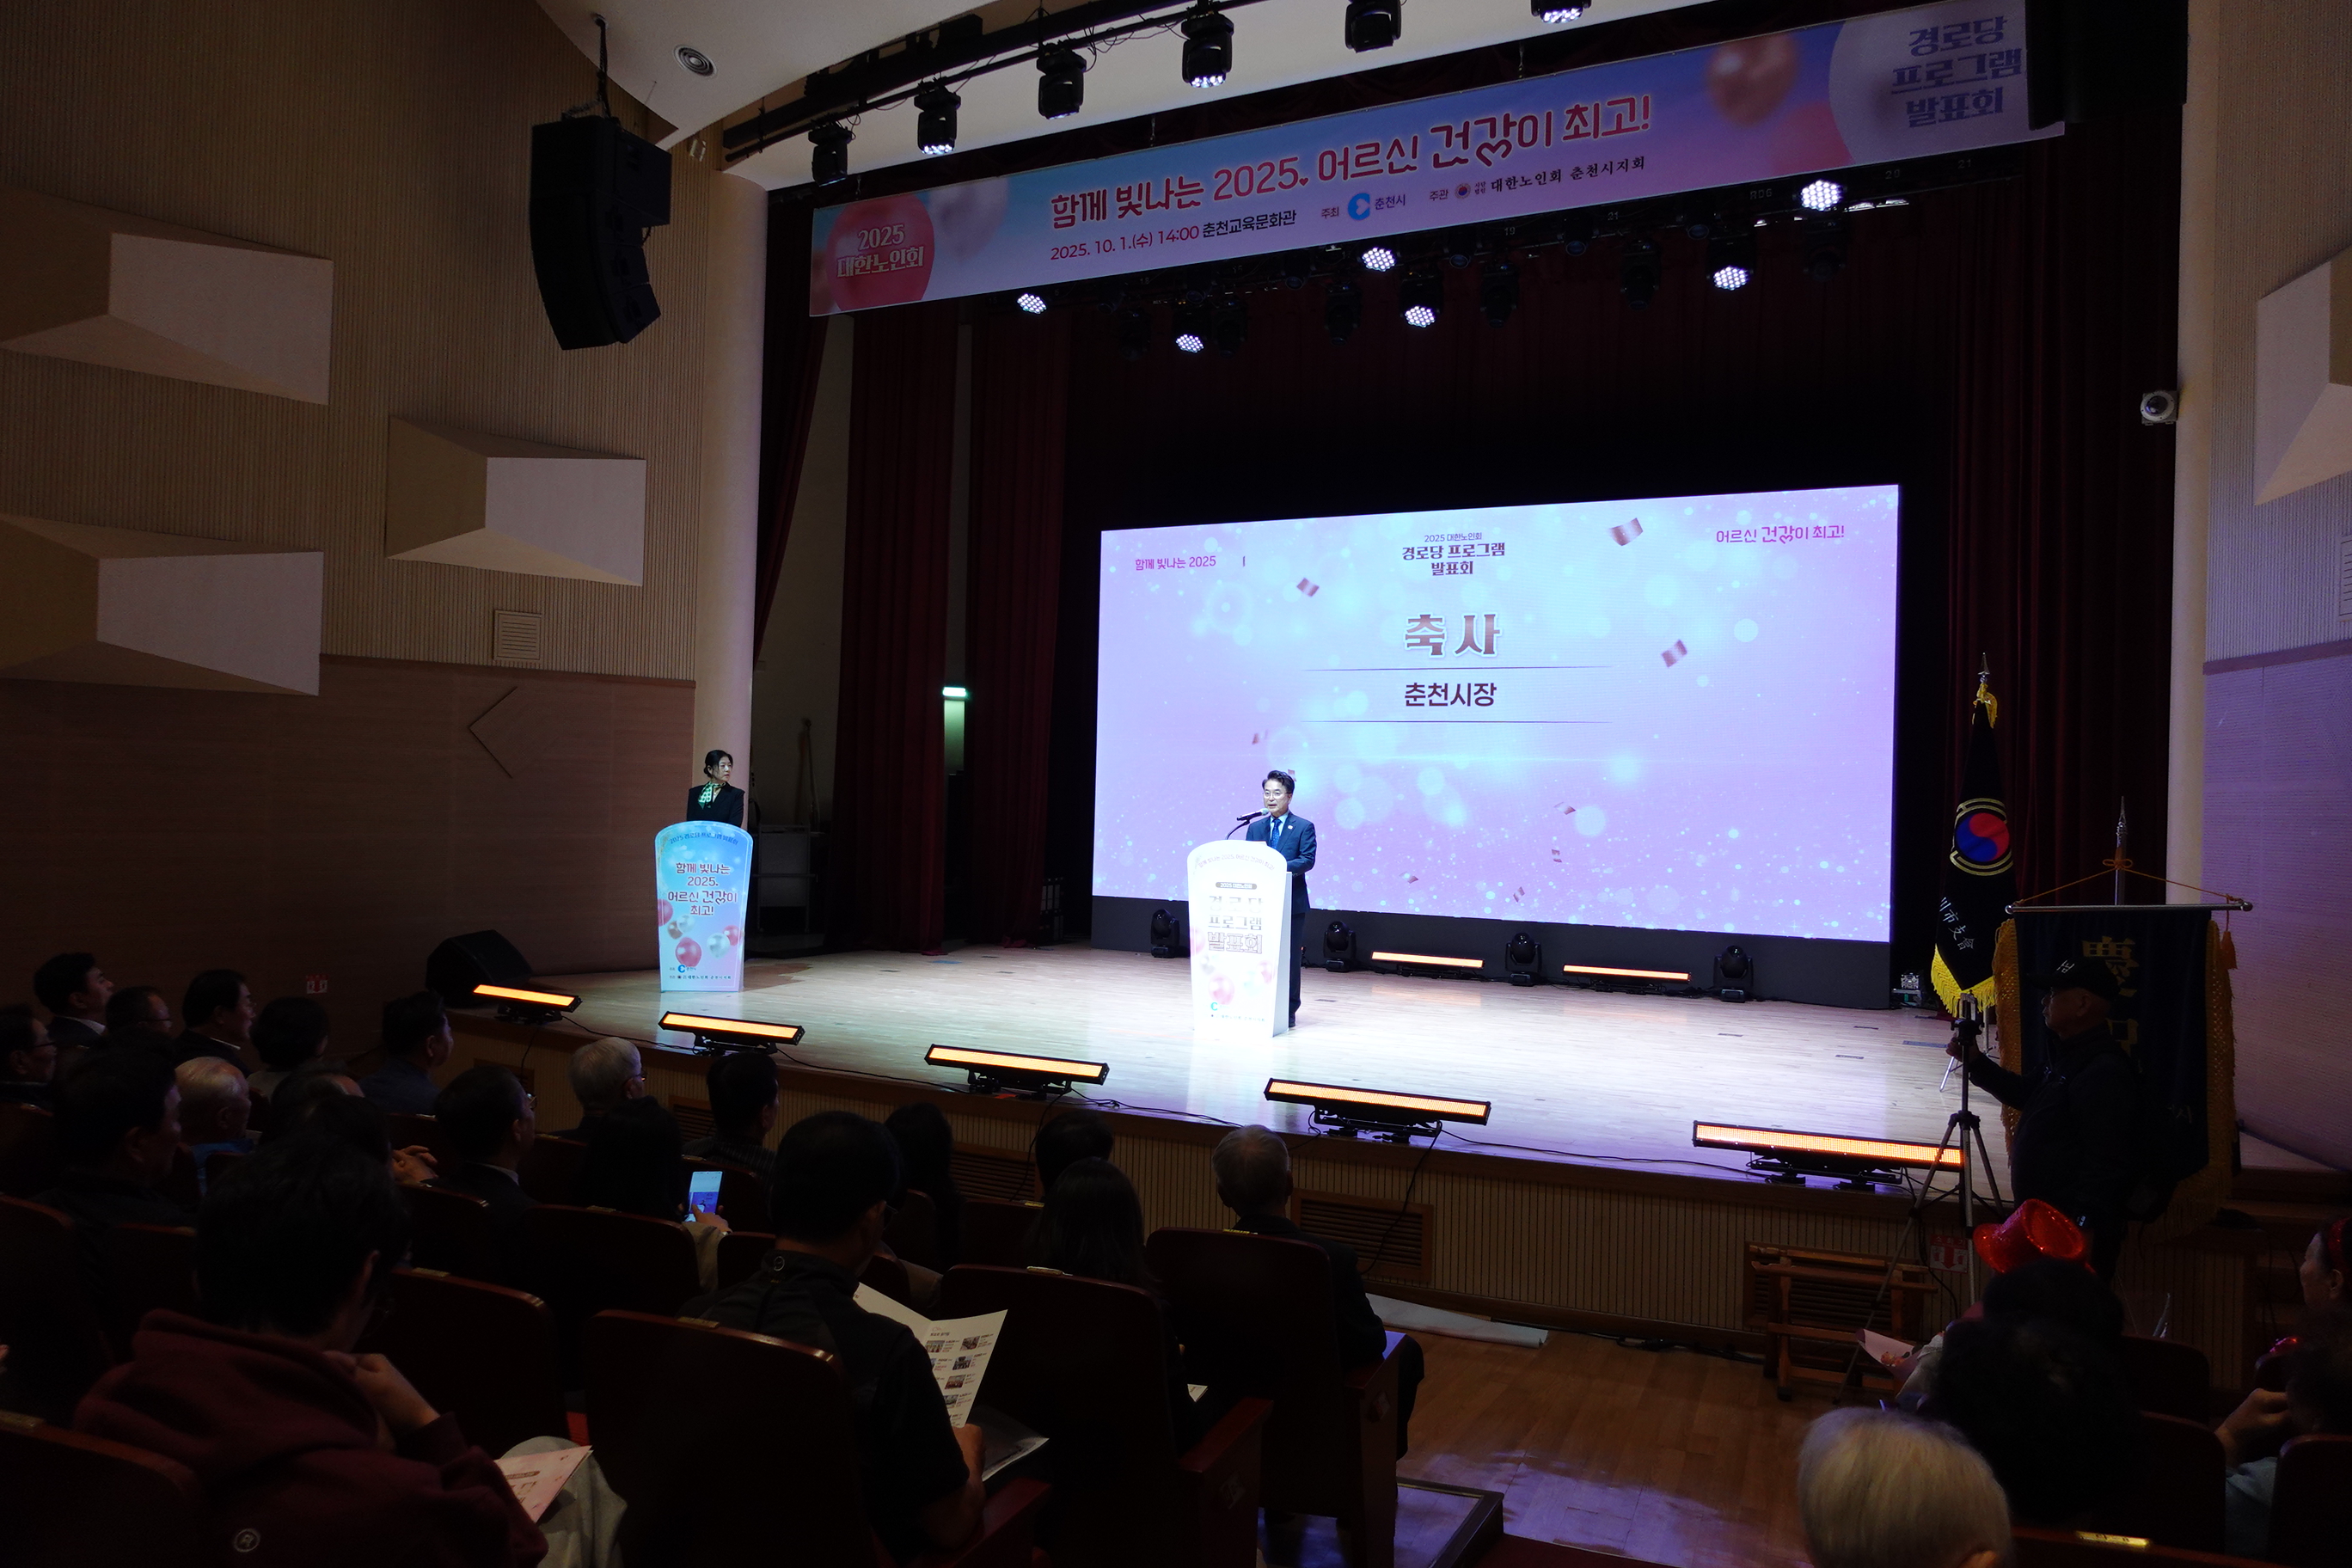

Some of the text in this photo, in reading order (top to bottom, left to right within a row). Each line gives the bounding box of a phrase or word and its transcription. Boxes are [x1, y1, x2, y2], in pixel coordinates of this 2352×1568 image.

[1908, 15, 2009, 57] 경로당
[1891, 48, 2022, 94] 프로그램
[1906, 87, 2004, 128] 발표회
[1050, 188, 1108, 230] 함께
[1117, 175, 1203, 217] 빛나는
[1318, 134, 1419, 182] 어르신
[1430, 111, 1553, 168] 건강이
[1562, 94, 1651, 143] 최고!
[1491, 155, 1645, 193] 대한노인회 춘천시지회
[1375, 193, 1406, 211] 춘천시
[1429, 188, 1449, 202] 주관
[1321, 206, 1340, 219] 주최
[1607, 211, 1620, 222] 21
[857, 224, 904, 252] 2025
[1050, 244, 1090, 260] 2025.
[1095, 239, 1116, 254] 10.
[1158, 225, 1200, 245] 14:00
[1202, 210, 1297, 238] 춘천교육문화관
[1504, 226, 1516, 236] 19
[836, 246, 925, 278] 대한노인회
[1424, 532, 1482, 542] 2025 대한노인회
[1716, 524, 1845, 544] 어르신 건강이 최고!
[1402, 542, 1505, 560] 경로당 프로그램
[1135, 555, 1216, 571] 함께 빛나는 2025
[1431, 560, 1473, 576] 발표회
[1405, 683, 1497, 707] 춘천시장
[676, 862, 731, 875] 함께 빛나는
[687, 876, 719, 886] 2025.
[668, 891, 738, 904] 어르신 건강이
[690, 905, 714, 916] 최고!
[1208, 914, 1263, 931] 프로그램
[1207, 931, 1263, 954] 발표회
